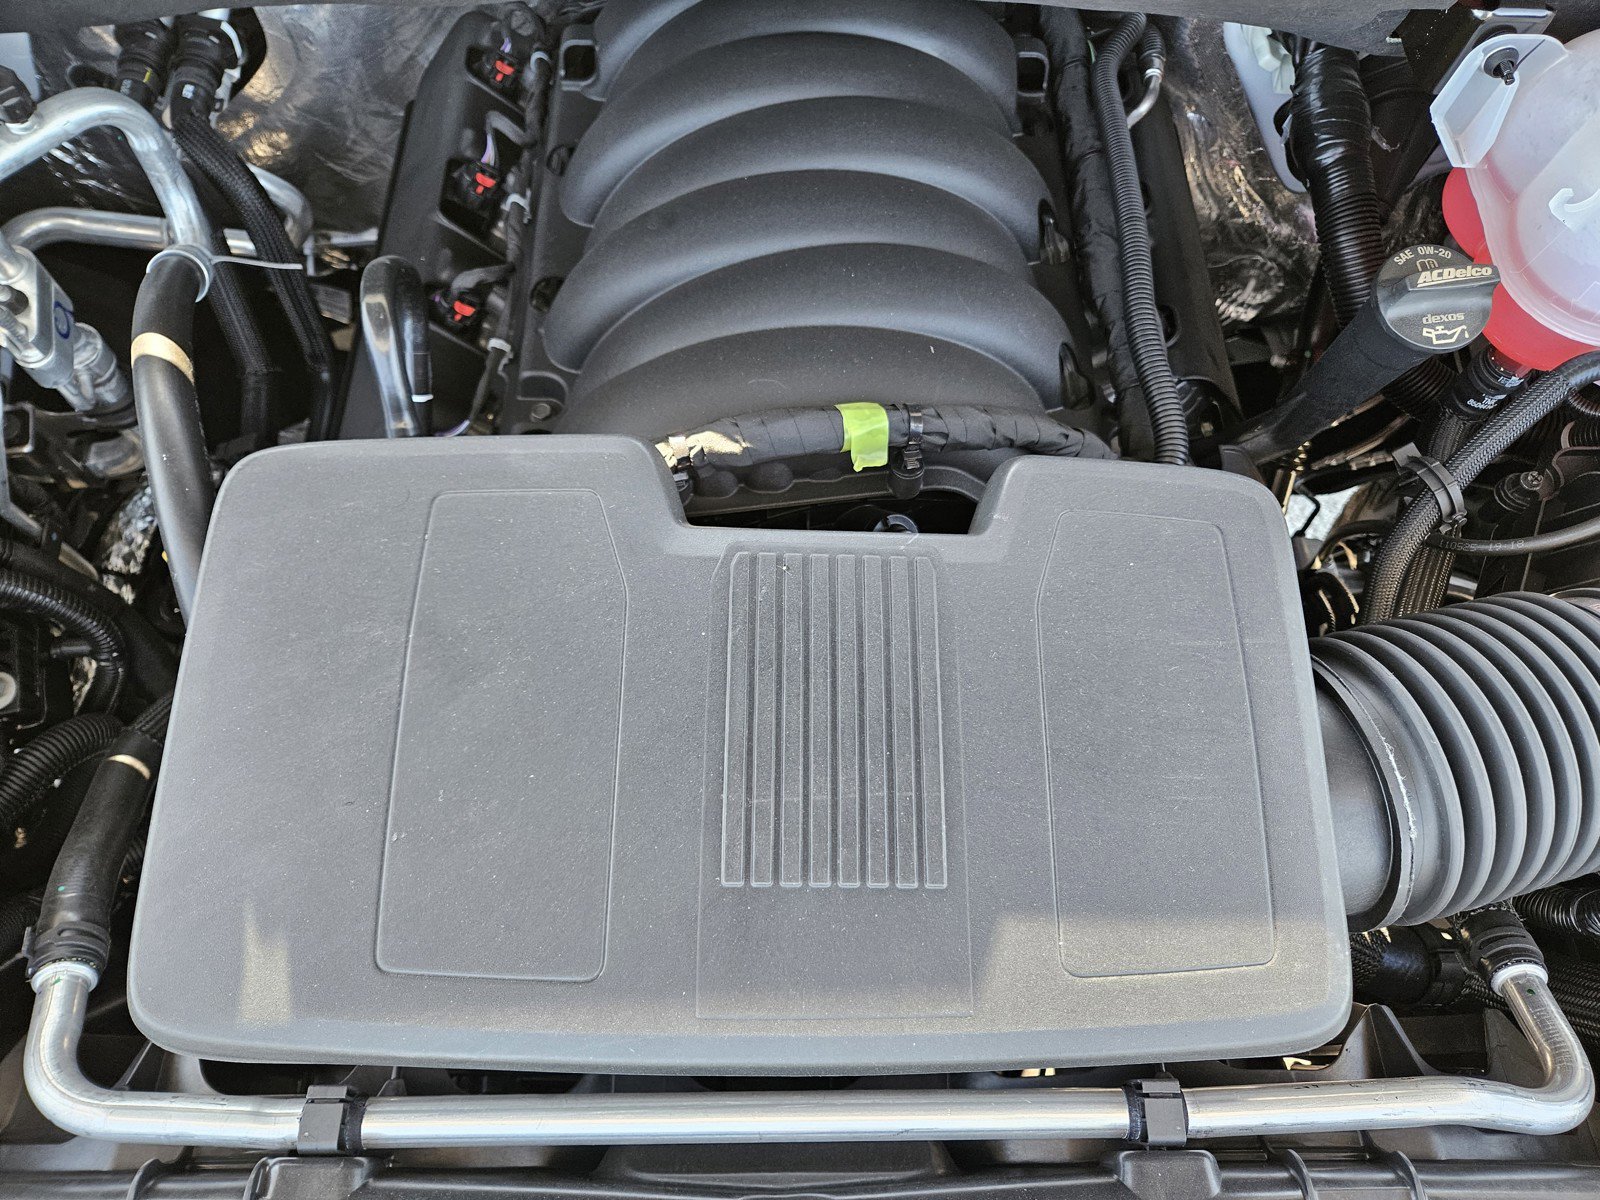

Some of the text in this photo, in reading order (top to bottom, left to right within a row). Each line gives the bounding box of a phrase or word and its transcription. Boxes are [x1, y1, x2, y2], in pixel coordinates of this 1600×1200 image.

[1393, 245, 1452, 266] SAE 0W-20
[1417, 265, 1493, 285] ACDelco
[1422, 312, 1465, 325] dexos
